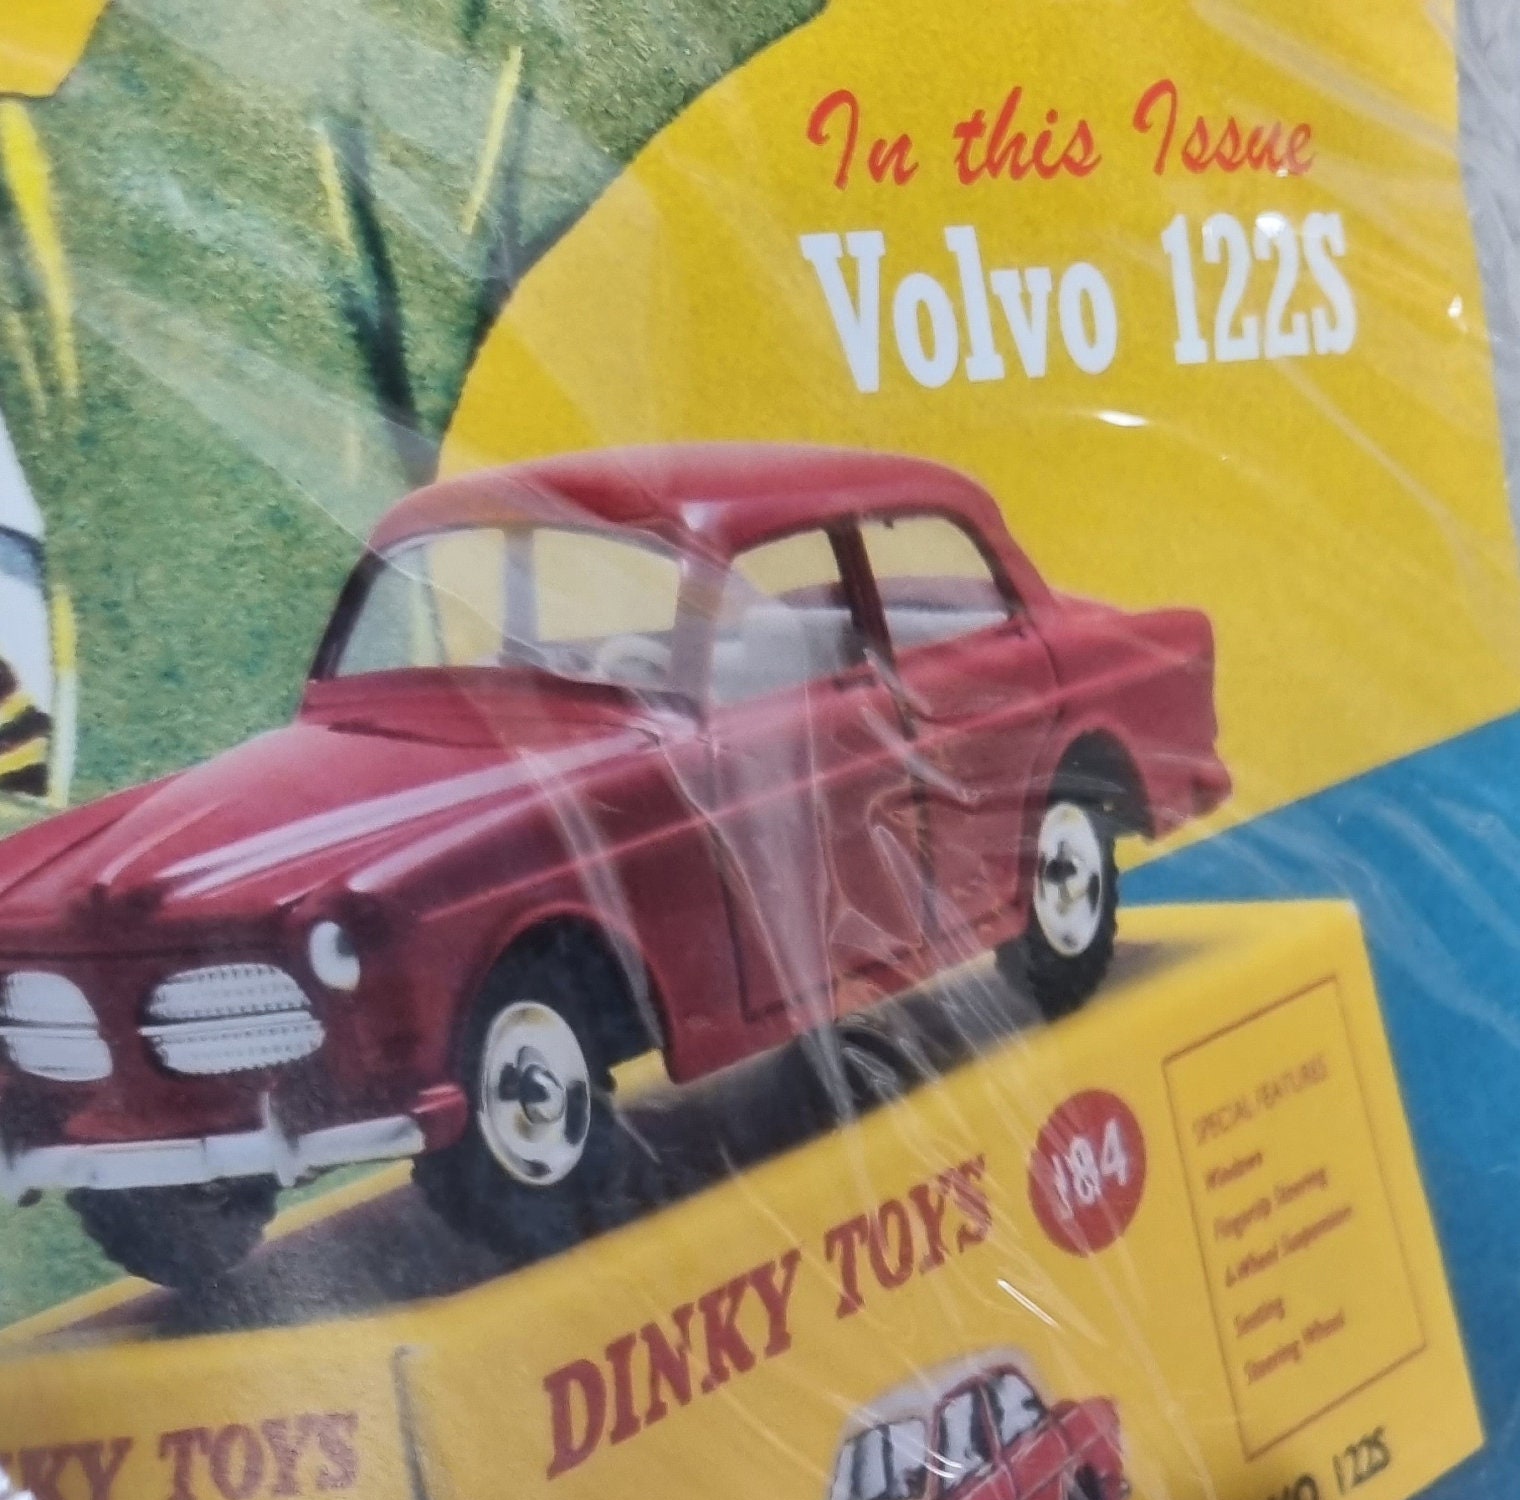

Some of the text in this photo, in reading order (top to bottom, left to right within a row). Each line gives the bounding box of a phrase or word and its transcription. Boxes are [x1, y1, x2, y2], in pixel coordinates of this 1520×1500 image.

[806, 79, 1316, 190] In this Issue
[800, 212, 1356, 394] Volvo 122S
[1050, 1116, 1128, 1221] 184
[543, 1152, 992, 1480] DINKY TOYS
[1332, 1424, 1392, 1496] 122S
